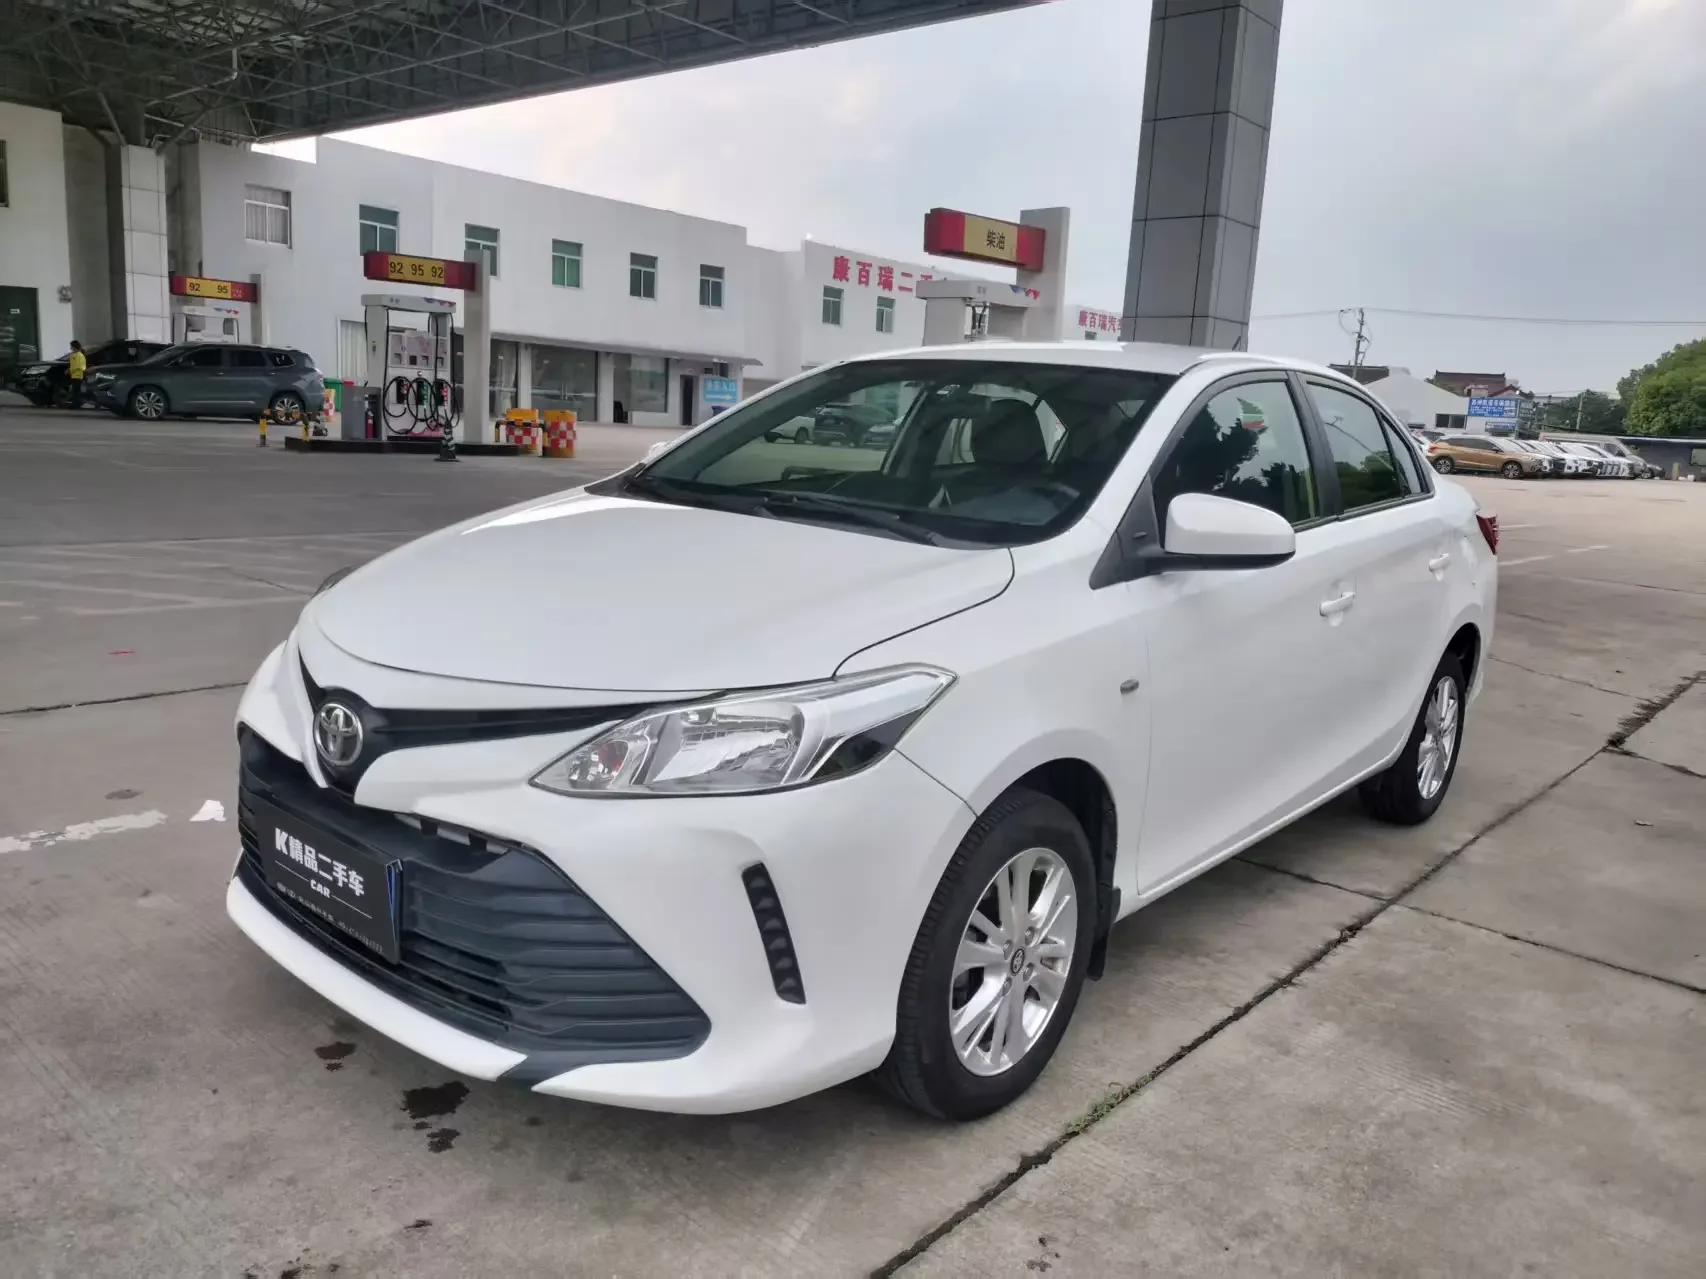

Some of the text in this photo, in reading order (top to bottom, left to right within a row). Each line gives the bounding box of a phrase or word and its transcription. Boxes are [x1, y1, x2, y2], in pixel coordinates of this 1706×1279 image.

[986, 230, 1006, 250] 柴油
[389, 261, 444, 279] 92 95 92
[832, 255, 933, 293] 康百瑞二
[188, 282, 201, 292] 92
[216, 285, 229, 294] 95
[310, 879, 331, 898] CAR
